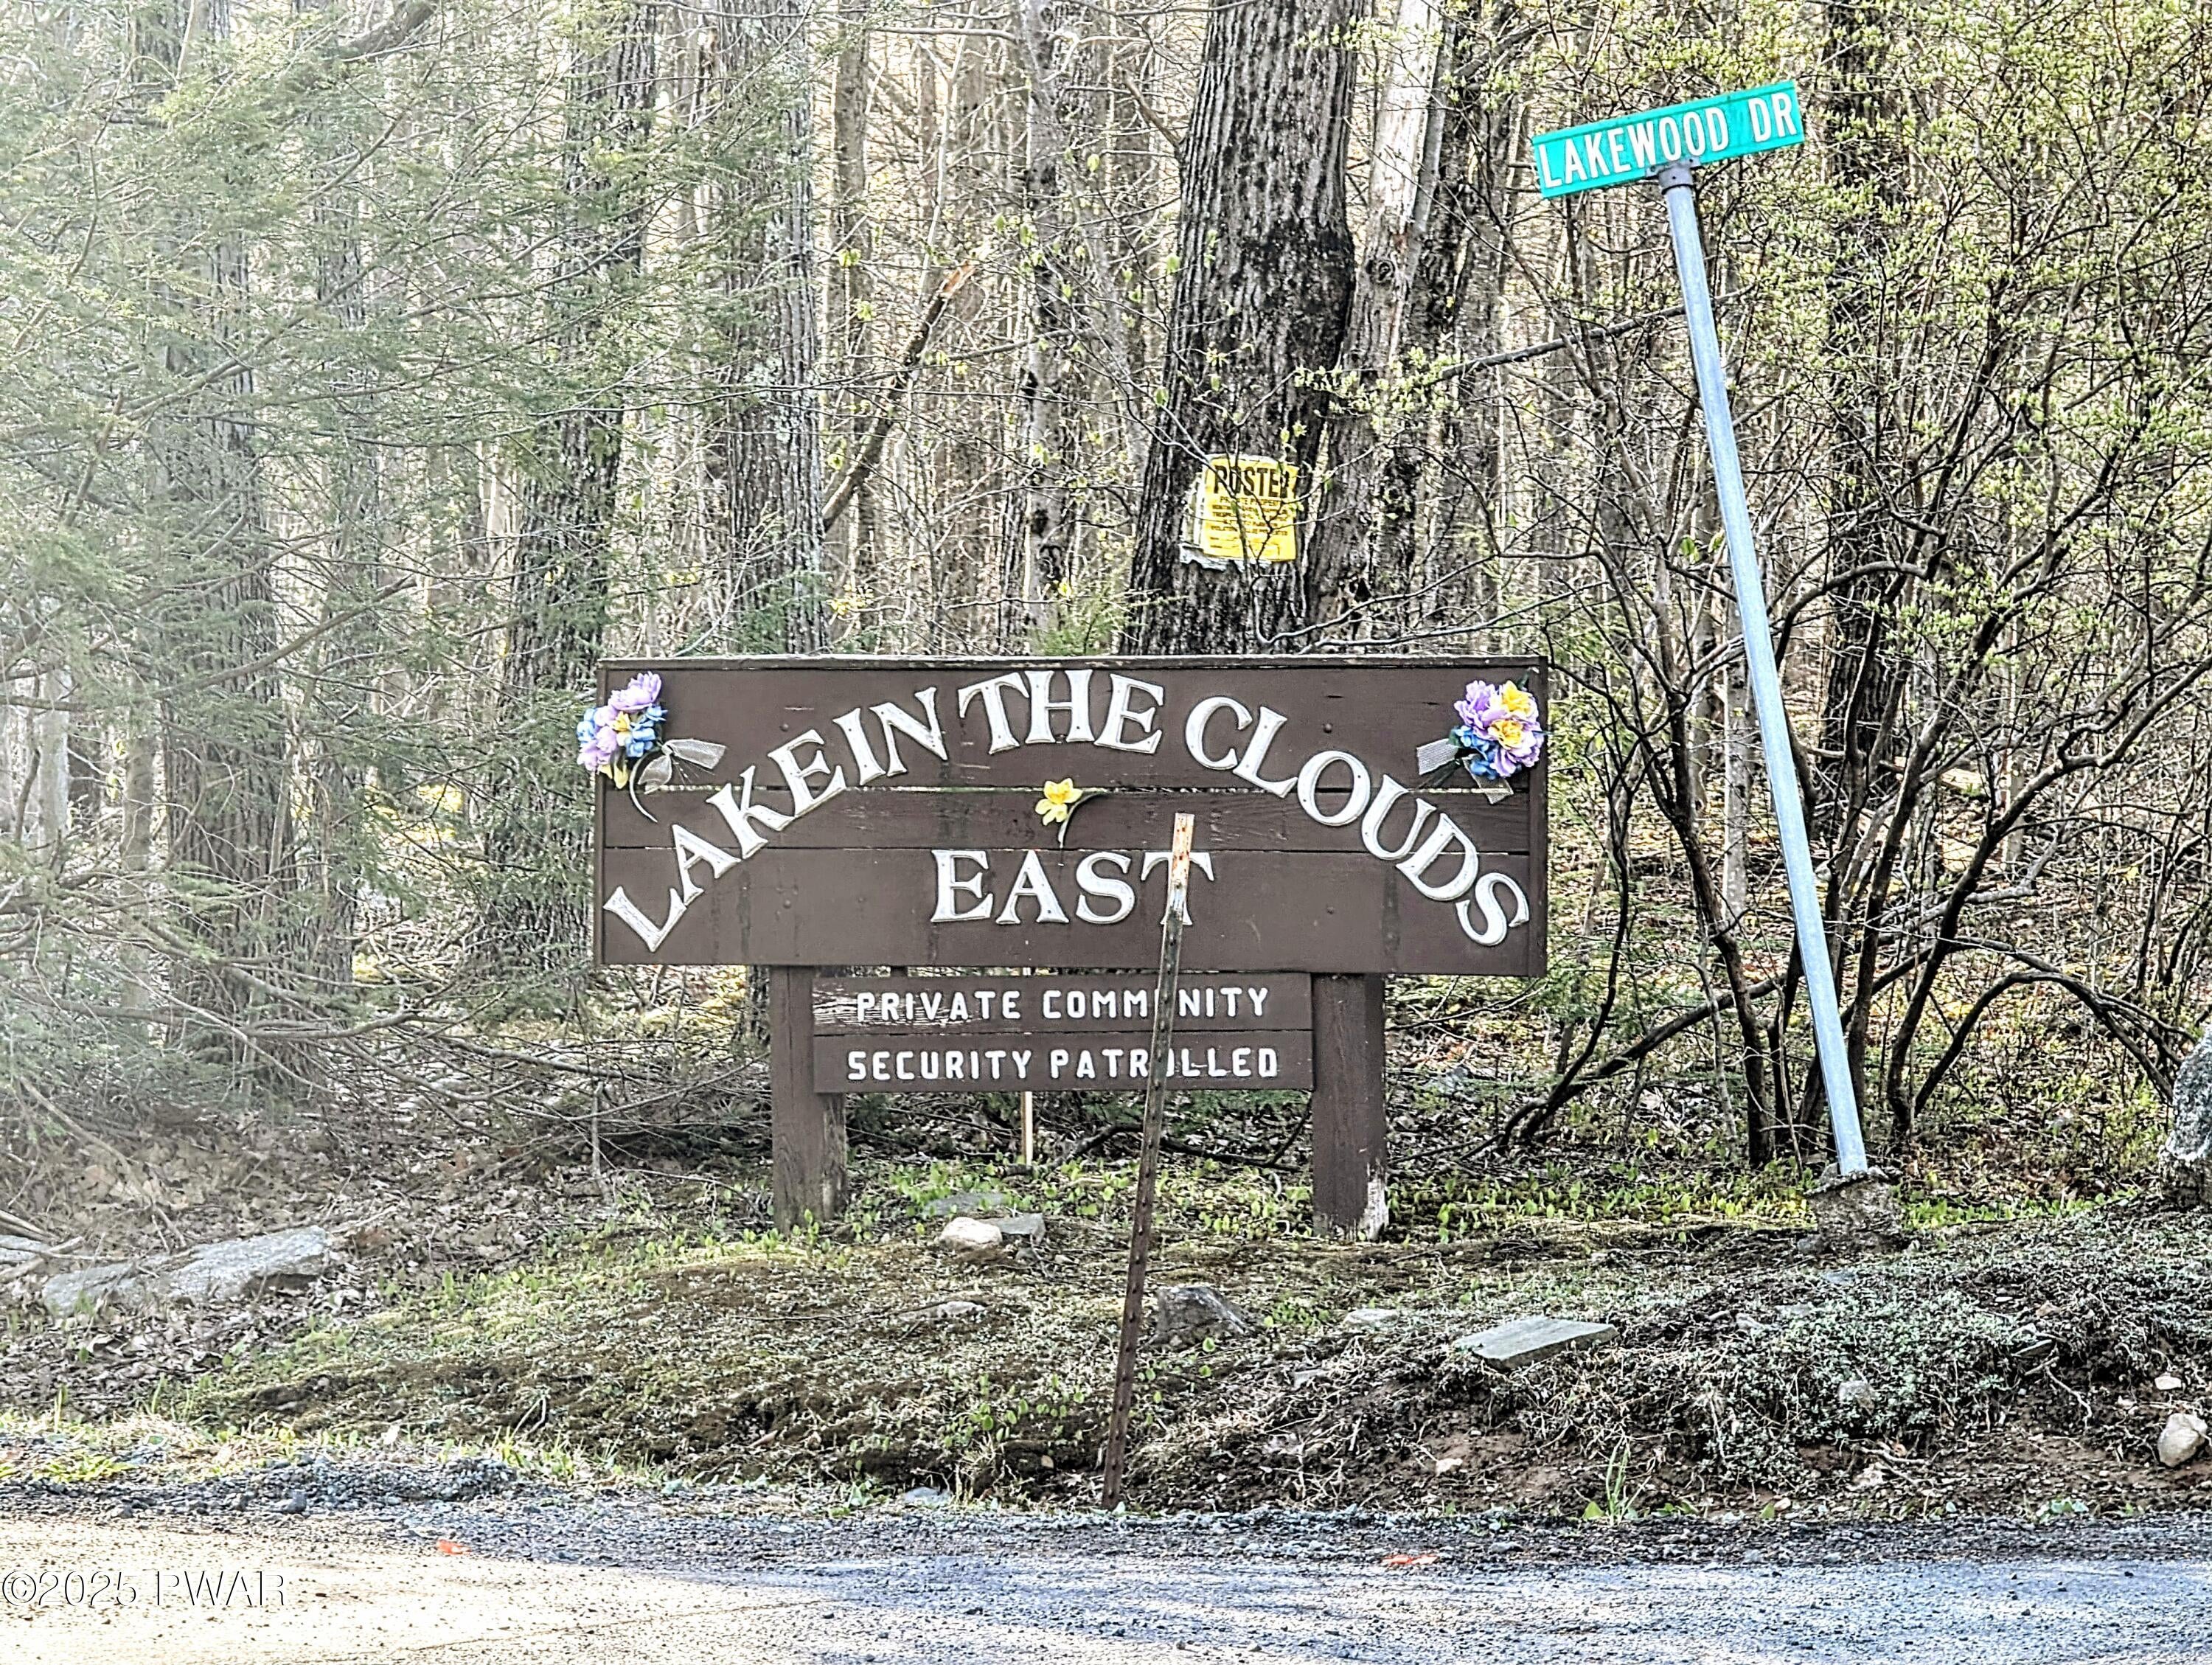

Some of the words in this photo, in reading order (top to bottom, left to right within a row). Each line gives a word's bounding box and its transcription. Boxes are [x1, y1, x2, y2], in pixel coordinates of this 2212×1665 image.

[1537, 106, 1730, 188] LAKEWOOD
[1747, 92, 1798, 143] DR
[603, 729, 846, 953] LAKE
[833, 686, 947, 786] IN
[958, 670, 1164, 755] THE
[1185, 695, 1530, 948] CLOUDS
[857, 990, 1021, 1021] PRIVATE
[1042, 987, 1269, 1019] COMMNITY
[847, 1049, 1032, 1081] SECURITY
